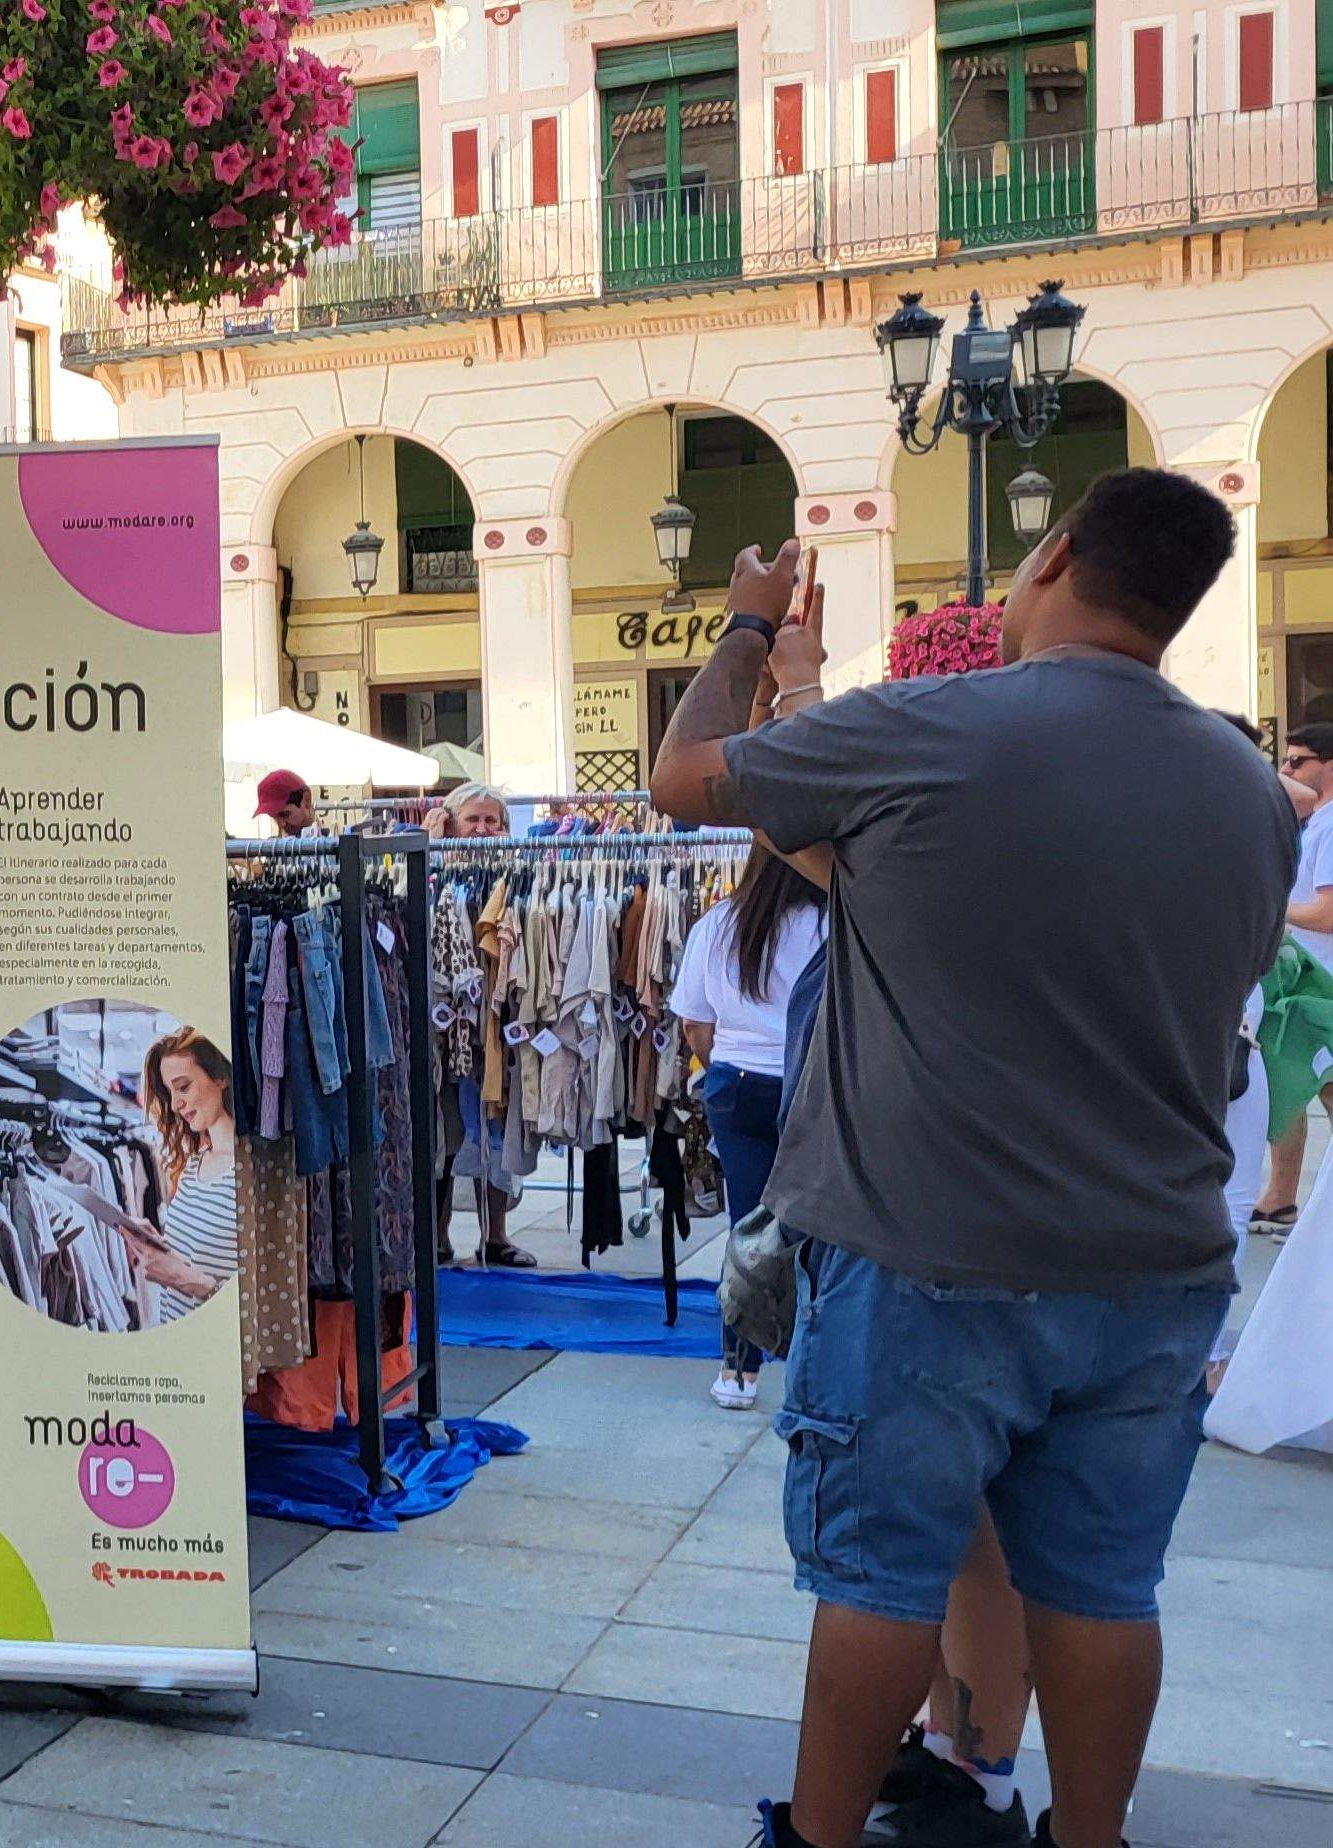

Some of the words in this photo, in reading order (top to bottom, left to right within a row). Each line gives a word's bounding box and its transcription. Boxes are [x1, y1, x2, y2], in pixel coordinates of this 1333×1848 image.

[62, 514, 194, 530] www.modare.org
[573, 686, 631, 702] LÁMAME
[575, 706, 607, 717] PERO
[574, 722, 594, 734] SIN
[599, 719, 619, 734] LL
[9, 855, 59, 869] itinerario
[61, 856, 112, 869] realizado
[114, 858, 139, 871] para
[141, 857, 168, 870] cada
[44, 875, 57, 885] se
[59, 873, 113, 885] desarrolla
[115, 873, 176, 888] trabajando
[21, 891, 36, 902] un
[38, 890, 85, 902] contrato
[87, 890, 121, 902] desde
[123, 890, 133, 902] el
[135, 890, 173, 904] primer
[58, 906, 122, 919] Pudiéndose
[125, 907, 171, 921] integrar,
[34, 925, 53, 935] sus
[55, 922, 114, 936] cualidades
[116, 923, 179, 938] personales,
[15, 940, 71, 952] diferentes
[73, 941, 106, 953] tareas
[108, 943, 115, 954] y
[117, 940, 206, 956] departamentos,
[82, 958, 96, 969] en
[98, 957, 108, 969] la
[110, 957, 161, 972] recogida,
[0, 973, 65, 986] tratamiento
[67, 975, 74, 988] y
[76, 973, 171, 987] comercialización.
[87, 1372, 152, 1387] Reciclamos
[154, 1375, 183, 1389] ropa,
[153, 1392, 206, 1405] personas
[23, 1409, 141, 1448] moda
[91, 1532, 112, 1550] Es
[116, 1534, 179, 1553] mucho
[183, 1532, 225, 1554] más
[116, 1567, 226, 1582] TROBADA
